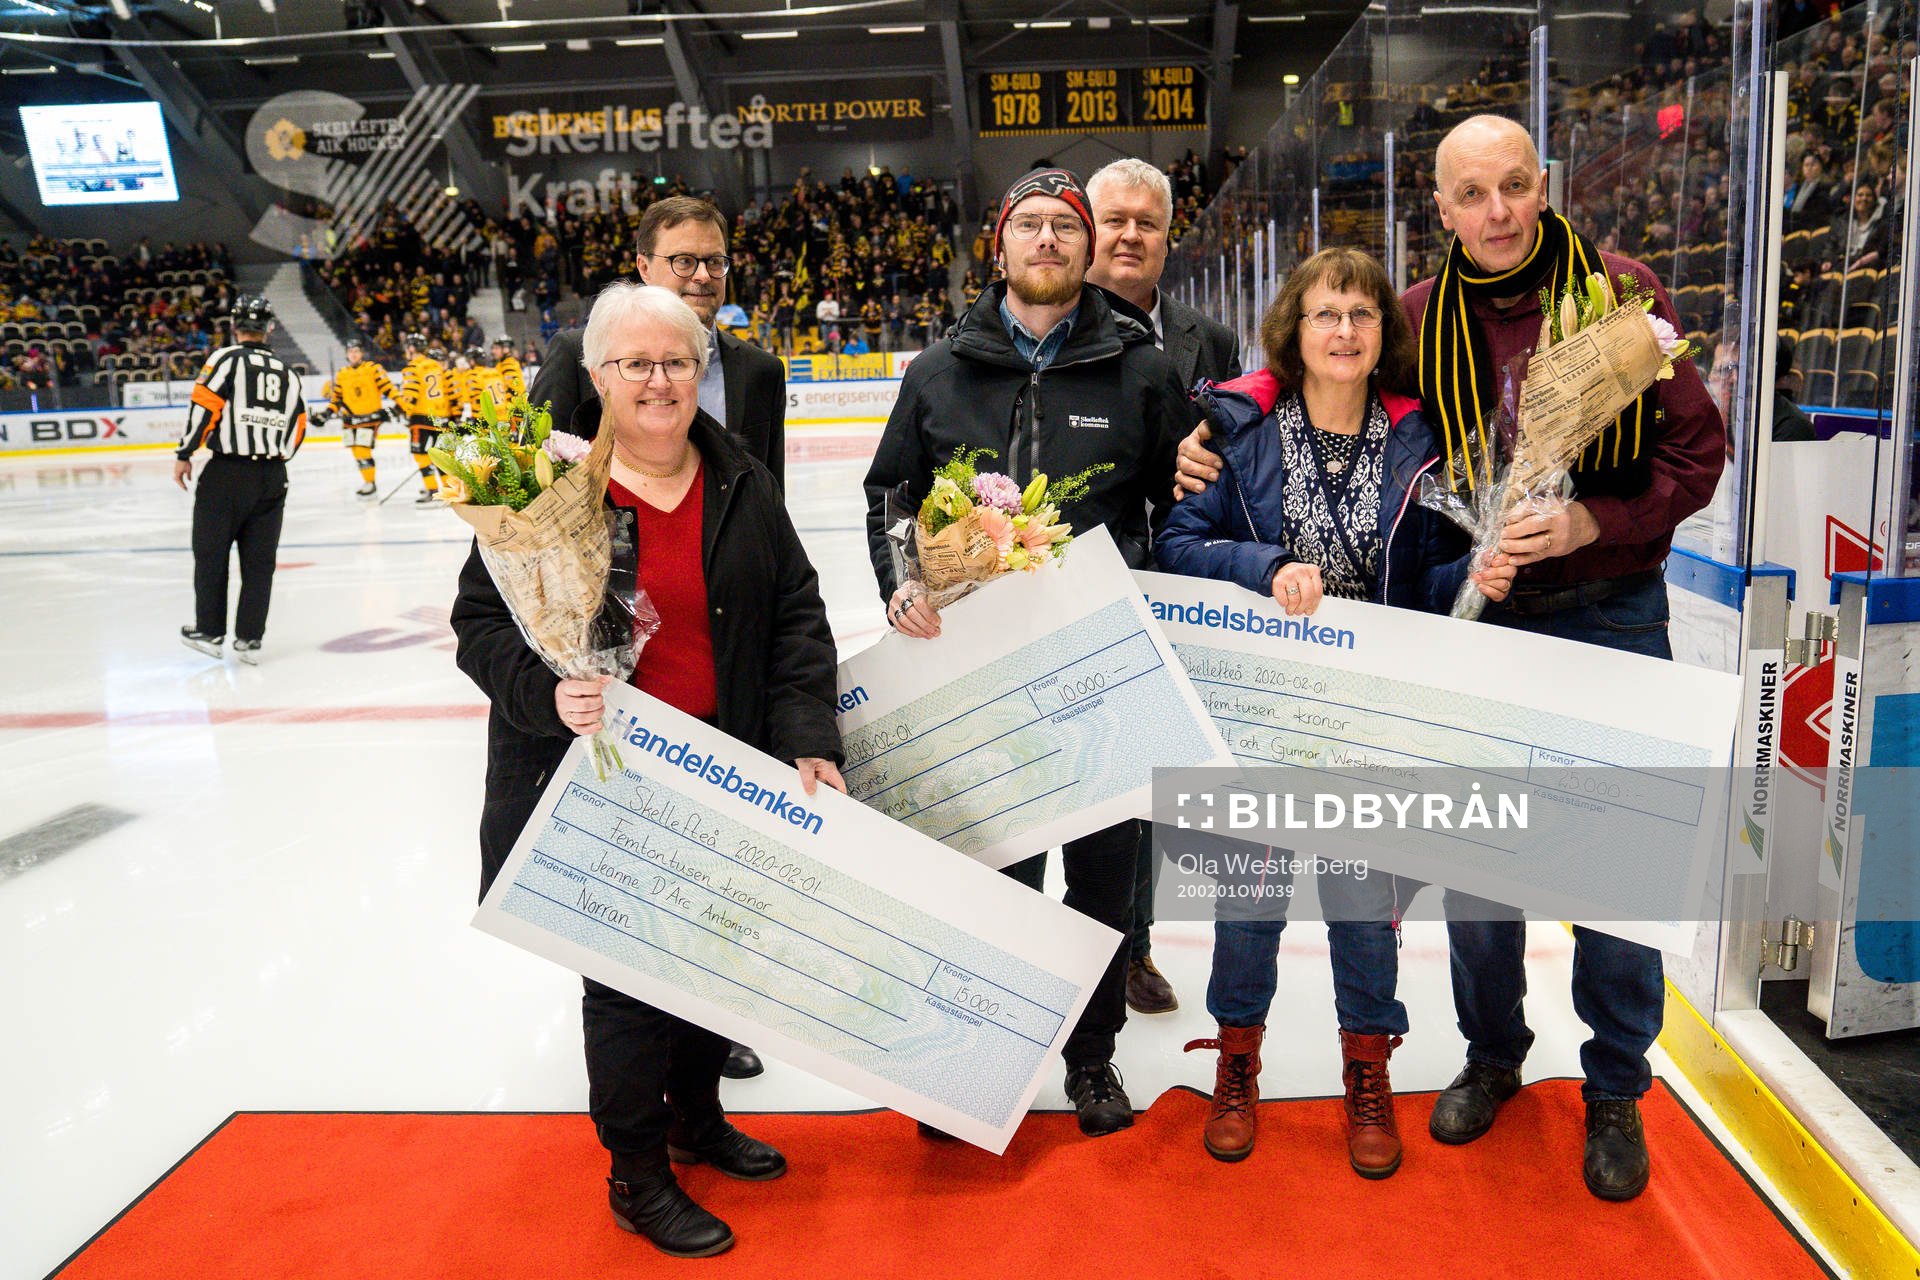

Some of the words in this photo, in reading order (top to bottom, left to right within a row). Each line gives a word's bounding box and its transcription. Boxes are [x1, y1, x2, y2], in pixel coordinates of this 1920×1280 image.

[990, 73, 1041, 91] SM-GULD
[1066, 70, 1117, 88] SM-GULD
[1143, 67, 1194, 86] SM-GULD
[737, 102, 828, 124] NORTH
[834, 98, 926, 120] POWER
[992, 93, 1041, 126] 1978
[1066, 89, 1118, 124] 2013
[1143, 87, 1195, 122] 2014
[256, 372, 281, 402] 18
[30, 417, 129, 441] BDX
[1143, 593, 1355, 650] andelsbanken
[1031, 675, 1059, 693] Kronor
[1254, 666, 1327, 695] 2020-02-01
[1050, 696, 1105, 726] Kassastämpel
[1292, 706, 1351, 731] kronor
[1752, 661, 1778, 816] NORRMASKINER
[1834, 671, 1859, 833] NORRMASKINER
[608, 708, 825, 836] Handelsbanken
[1239, 736, 1260, 750] och
[1271, 737, 1321, 762] Gunnar
[1331, 748, 1422, 783] Westermark
[1537, 750, 1576, 767] Kronor
[570, 786, 607, 810] Kronor
[1532, 787, 1607, 814] Kassastämpel
[553, 821, 568, 835] Till
[629, 785, 720, 848] Skellefteå
[734, 839, 822, 895] 2020-02-01
[532, 854, 589, 886] Underskrift
[610, 815, 714, 889] Femtontusen
[719, 877, 773, 912] kronor
[575, 887, 633, 930] Norran
[589, 850, 640, 890] Jeanne
[699, 903, 761, 941] Antonios
[942, 964, 973, 983] Kronor
[924, 995, 983, 1029] Kassastämpel
